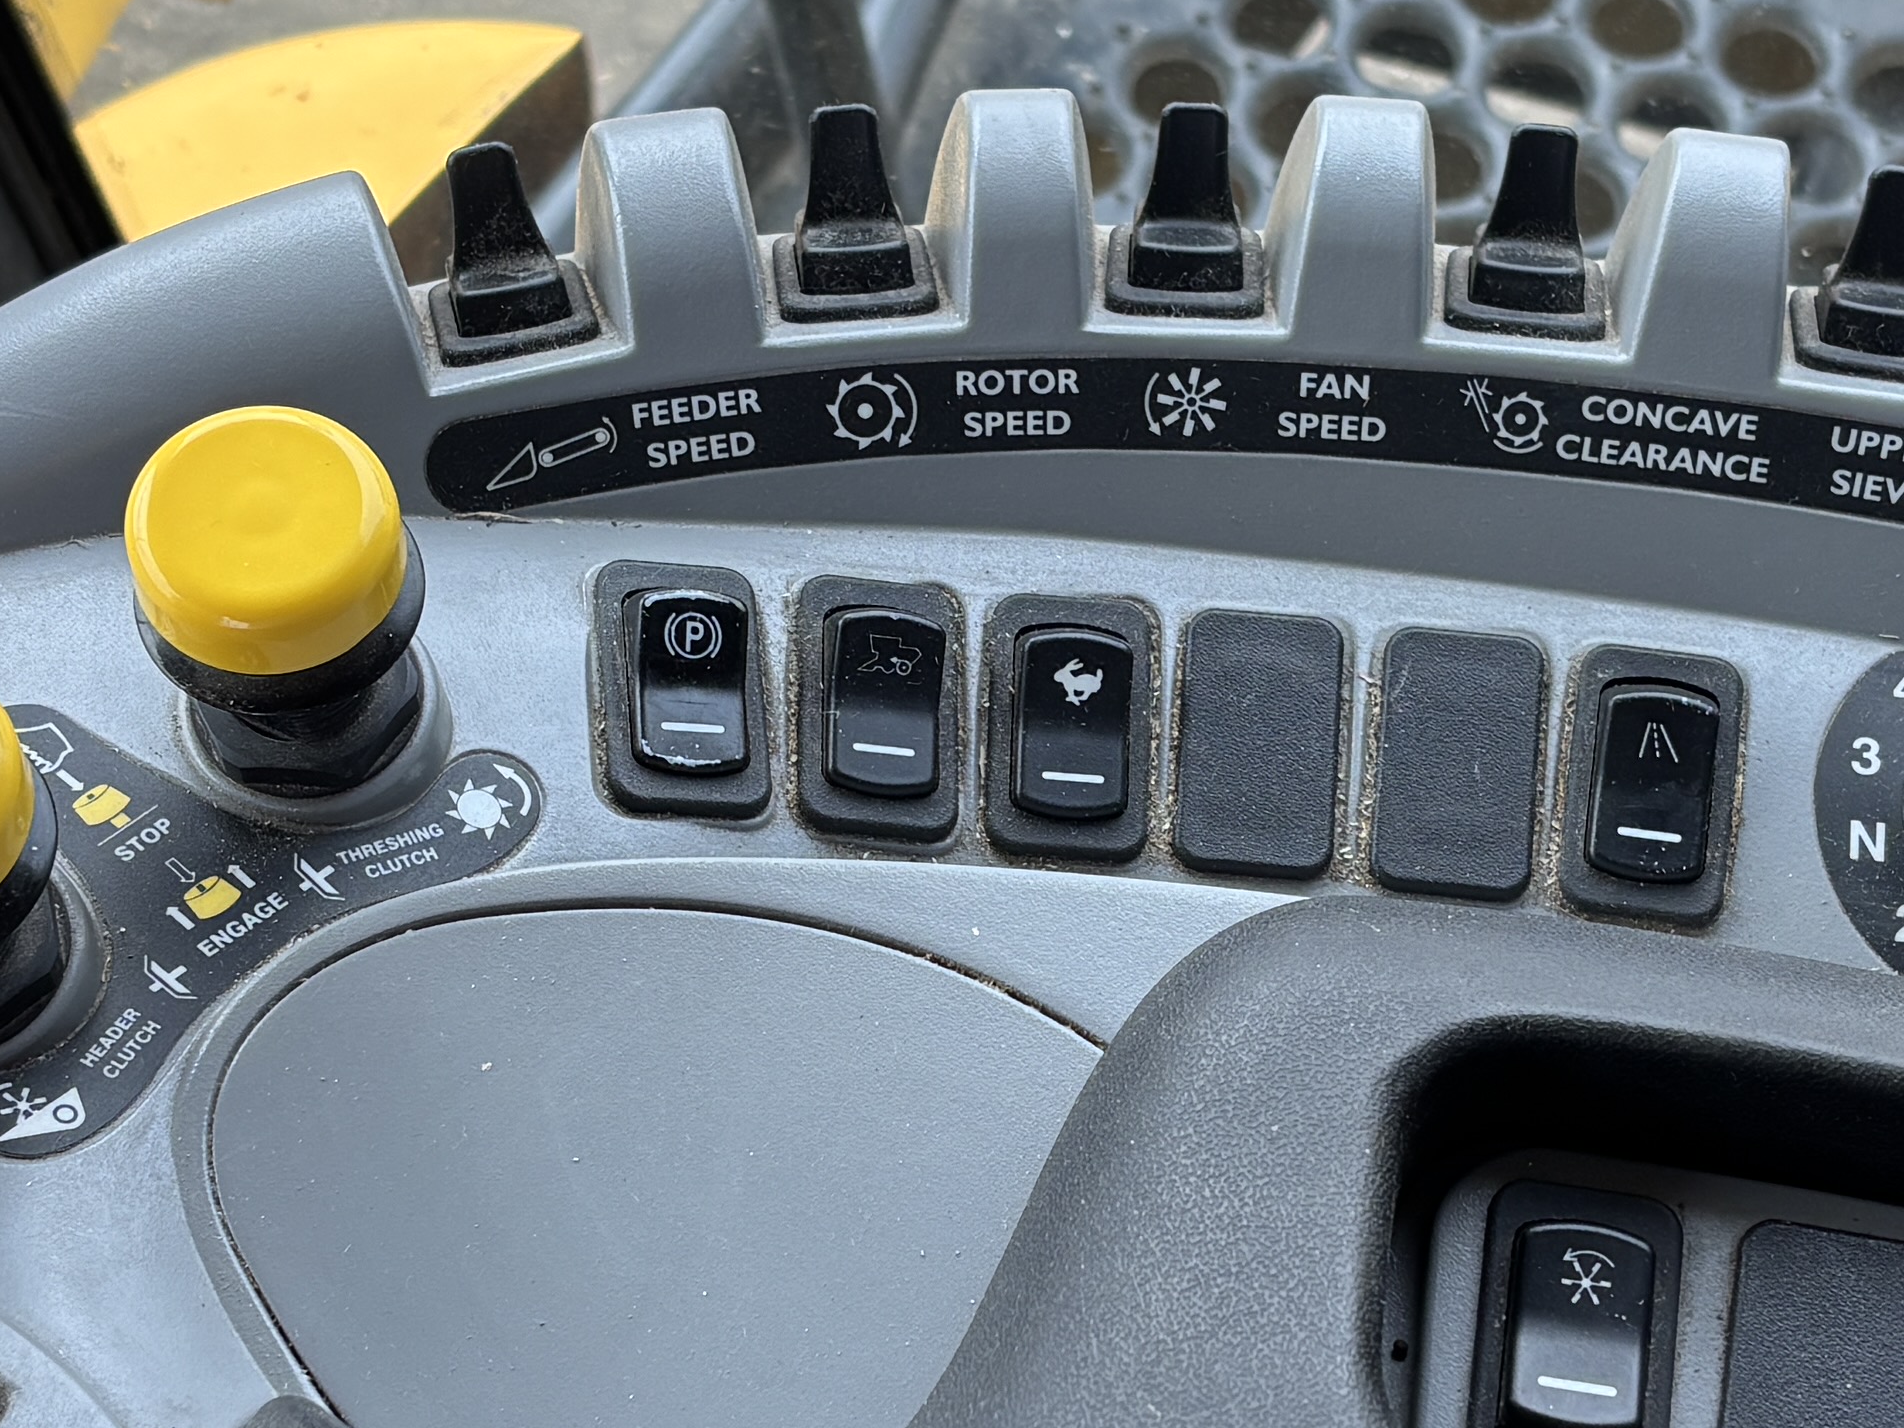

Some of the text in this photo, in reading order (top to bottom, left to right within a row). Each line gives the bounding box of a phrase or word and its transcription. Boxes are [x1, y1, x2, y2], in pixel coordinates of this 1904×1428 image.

[955, 368, 1080, 396] ROTOR
[1298, 372, 1370, 401] FAN
[631, 388, 762, 428] FEEDER
[963, 410, 1072, 438] SPEED
[1277, 411, 1387, 442] SPEED
[1581, 395, 1759, 441] CONCAVE
[646, 431, 756, 468] SPEED
[1555, 433, 1770, 484] CLEARANCE
[685, 620, 705, 653] P
[1851, 736, 1882, 776] 3
[113, 817, 172, 862] STOP
[335, 822, 445, 865] THRESHING
[1849, 819, 1886, 863] N
[364, 846, 440, 879] CLUTCH
[196, 891, 290, 958] ENGAGE
[79, 1007, 142, 1068] HEADER
[102, 1020, 162, 1079] CLUTCH
